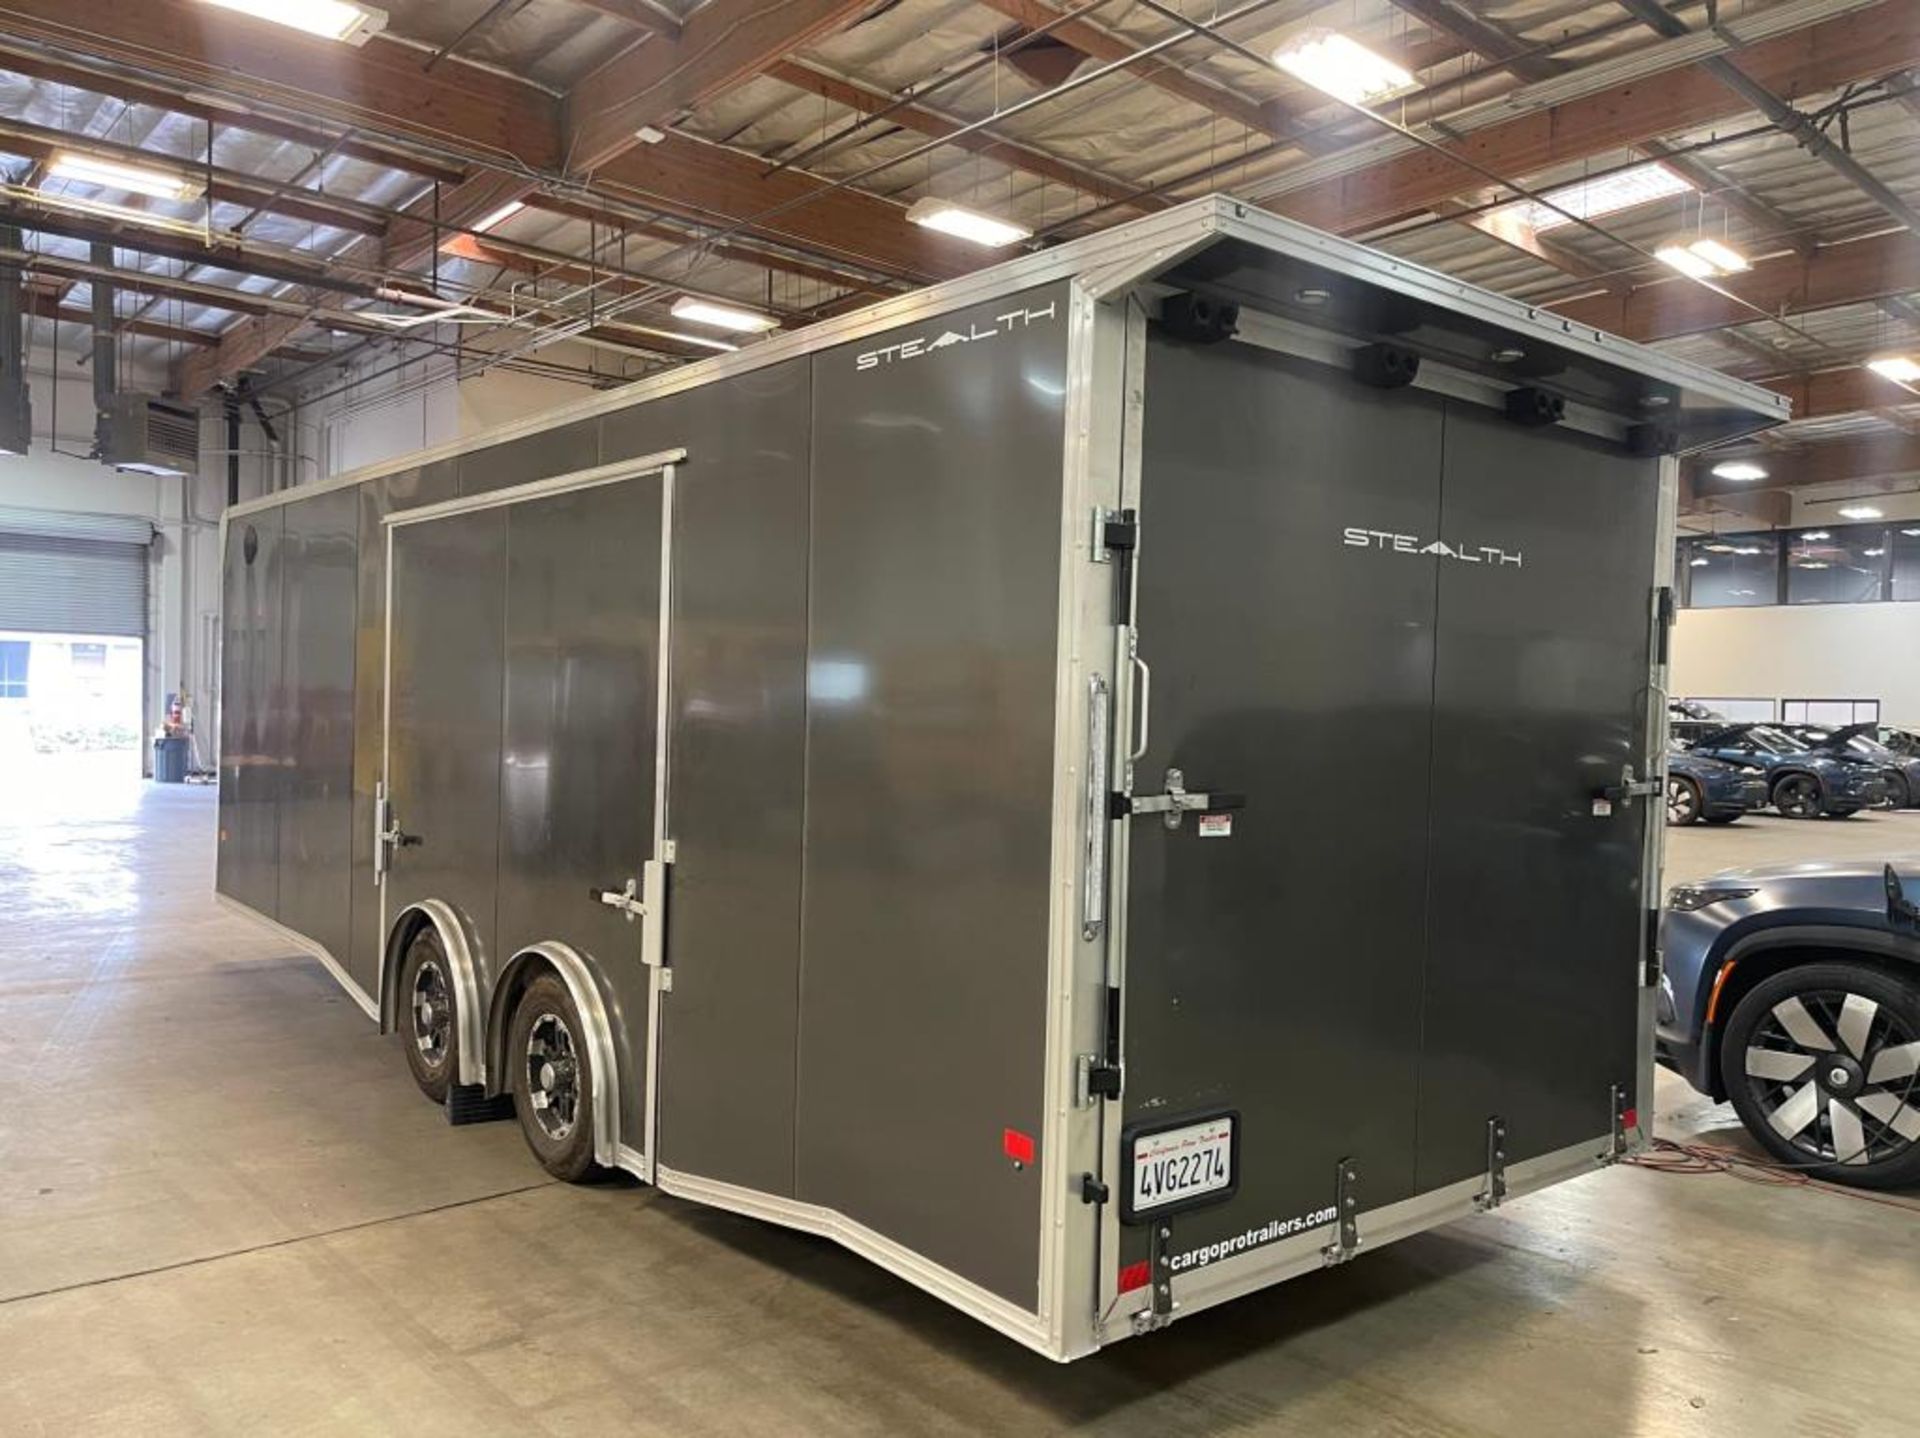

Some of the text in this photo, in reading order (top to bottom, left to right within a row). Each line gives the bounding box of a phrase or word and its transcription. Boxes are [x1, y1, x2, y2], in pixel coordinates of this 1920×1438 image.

[856, 301, 1055, 370] STEALTH
[1344, 527, 1522, 568] STEALTH
[1141, 1147, 1225, 1198] 4VG2274
[1170, 1206, 1338, 1271] cargoprotrailers.com
